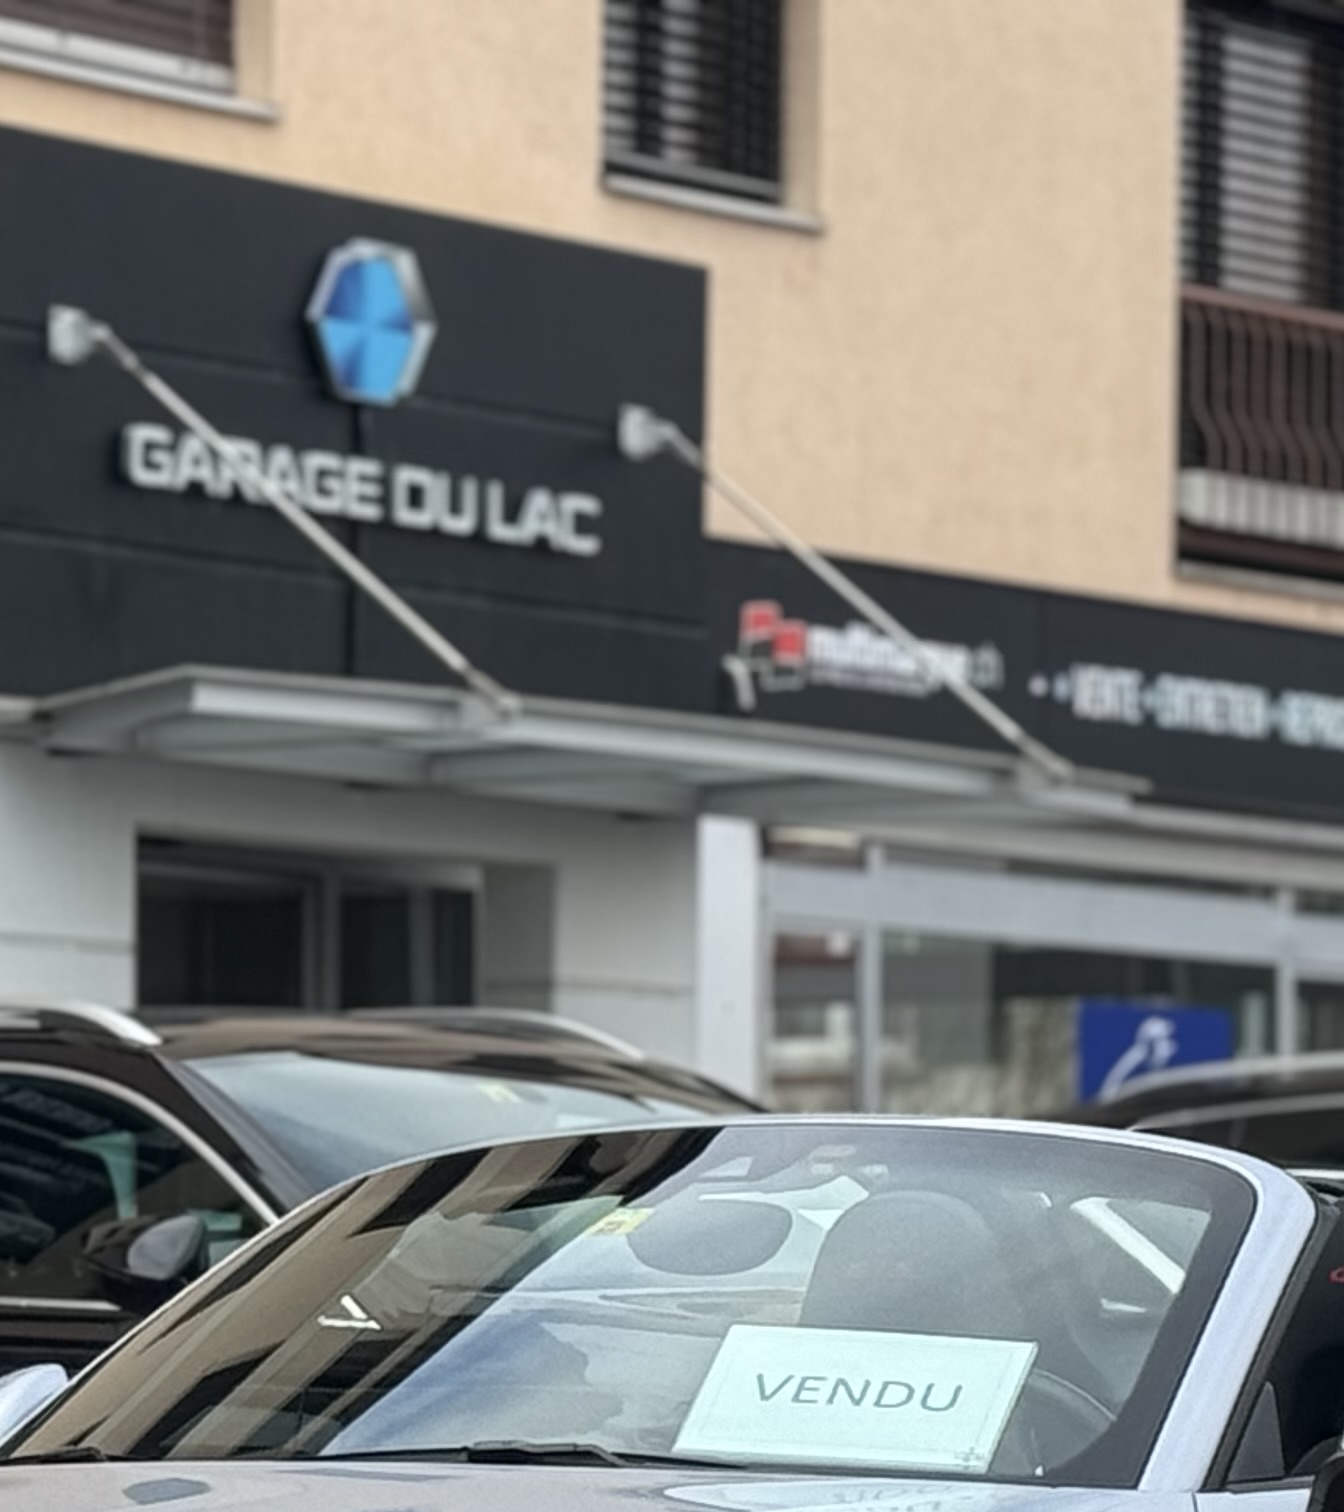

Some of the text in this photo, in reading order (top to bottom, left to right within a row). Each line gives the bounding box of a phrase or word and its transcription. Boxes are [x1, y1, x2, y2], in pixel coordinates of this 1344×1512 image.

[123, 423, 603, 557] GARAGE DU LAC
[756, 1373, 963, 1412] VENDU
